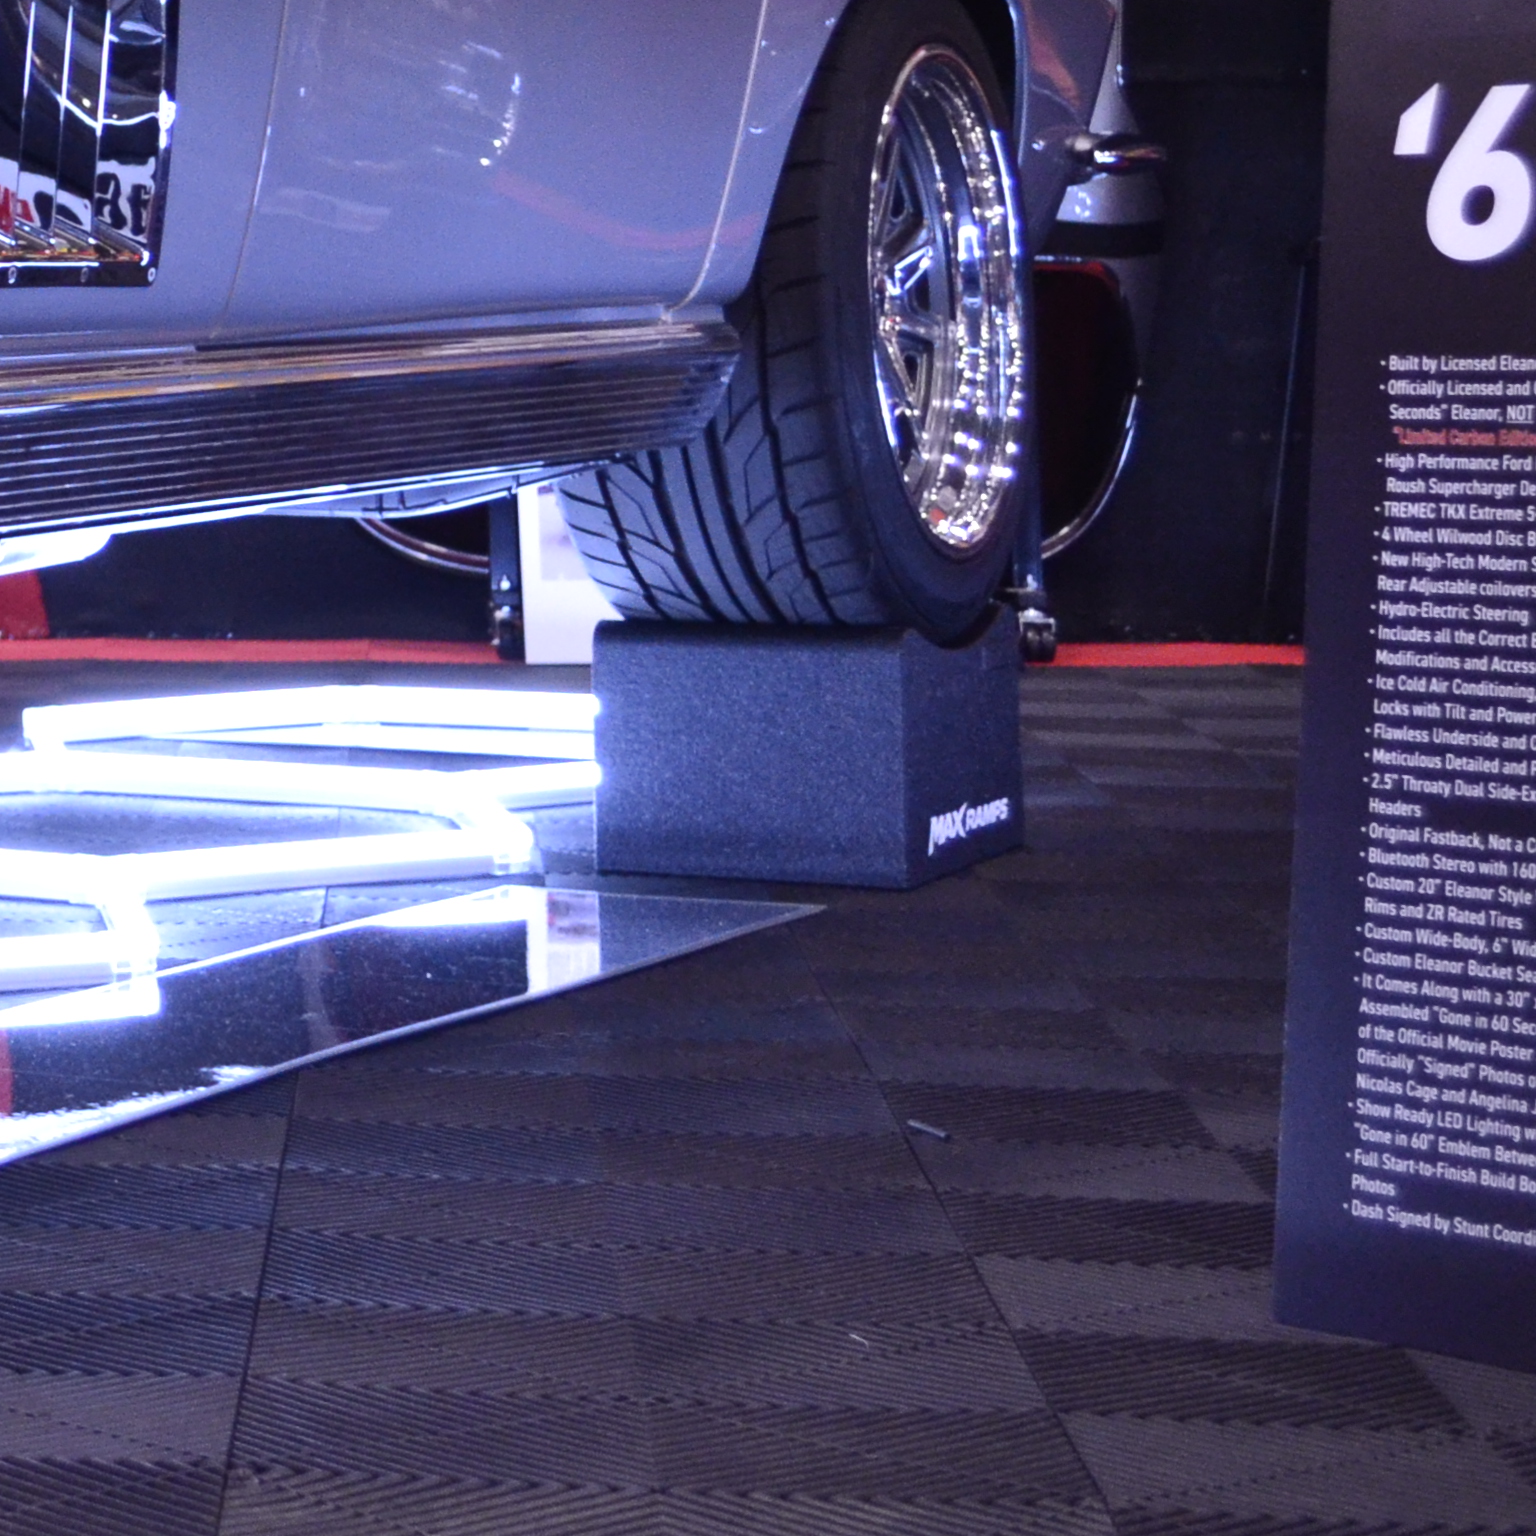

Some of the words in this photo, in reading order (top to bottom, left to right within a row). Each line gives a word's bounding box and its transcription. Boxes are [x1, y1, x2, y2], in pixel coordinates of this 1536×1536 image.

[1389, 355, 1419, 370] Built
[1422, 356, 1437, 374] by
[1441, 355, 1497, 370] Licensed
[1500, 355, 1536, 370] Elean
[1388, 380, 1444, 398] Officially
[1447, 380, 1503, 395] Licensed
[1506, 381, 1530, 395] and
[1389, 404, 1448, 420] Seconds"
[1451, 405, 1503, 422] Eleanor,
[1507, 405, 1535, 423] NOT
[1385, 453, 1414, 472] High
[1418, 453, 1498, 470] Performance
[1503, 455, 1532, 470] Ford
[1387, 477, 1425, 493] Roush
[1429, 478, 1517, 499] Supercharger
[1383, 501, 1436, 518] TREMEC
[1439, 503, 1466, 519] TKX
[1470, 504, 1523, 521] Extreme
[1381, 526, 1391, 541] 4
[1393, 527, 1433, 543] Wheel
[1437, 528, 1492, 545] Wilwood
[1496, 530, 1523, 546] Disc
[1381, 551, 1408, 566] New
[1412, 552, 1474, 571] High-Tech
[1478, 555, 1527, 571] Modern
[1378, 575, 1407, 591] Rear
[1409, 577, 1477, 596] Adjustable
[1379, 600, 1469, 619] Hydro-Electric
[1473, 604, 1529, 626] Steering
[1378, 625, 1431, 642] Includes
[1434, 628, 1450, 643] all
[1455, 629, 1475, 644] the
[1478, 629, 1527, 647] Correct
[1376, 649, 1460, 669] Modifications
[1464, 656, 1487, 670] and
[1376, 674, 1394, 690] Ice
[1398, 675, 1426, 692] Cold
[1429, 677, 1449, 693] Air
[1374, 699, 1409, 716] Locks
[1412, 702, 1440, 717] with
[1444, 703, 1466, 719] Tilt
[1469, 707, 1493, 721] and
[1374, 723, 1428, 742] Flawless
[1433, 728, 1499, 747] Underside
[1502, 735, 1526, 750] and
[1372, 748, 1441, 768] Meticulous
[1446, 754, 1499, 773] Detailed
[1502, 760, 1527, 775] and
[1371, 773, 1398, 789] 2.5"
[1402, 775, 1451, 797] Throaty
[1455, 780, 1483, 797] Dual
[1369, 797, 1421, 817] Headers
[928, 802, 967, 857] MAX
[1369, 823, 1420, 844] Original
[1423, 828, 1484, 850] Fastback,
[1488, 834, 1511, 851] Not
[1515, 840, 1523, 852] a
[1368, 847, 1429, 868] Bluetooth
[1433, 854, 1475, 873] Stereo
[1479, 860, 1507, 876] with
[1367, 872, 1414, 892] Custom
[1418, 878, 1441, 894] 20"
[1445, 880, 1495, 900] Eleanor
[1499, 886, 1532, 906] Style
[1364, 897, 1396, 915] Rims
[1399, 903, 1423, 918] and
[1426, 904, 1444, 920] ZR
[1448, 906, 1486, 925] Rated
[1489, 911, 1523, 929] Tires
[1364, 923, 1412, 942] Custom
[1416, 928, 1489, 954] Wide-Body,
[1363, 947, 1411, 967] Custom
[1415, 953, 1464, 974] Eleanor
[1468, 960, 1512, 980] Bucket
[1362, 973, 1371, 988] It
[1375, 974, 1418, 994] Comes
[1421, 980, 1459, 1003] Along
[1462, 987, 1490, 1003] with
[1494, 993, 1502, 1005] a
[1507, 991, 1530, 1007] 30"
[1359, 997, 1428, 1021] Assembled
[1432, 1006, 1471, 1027] "Gone
[1475, 1012, 1488, 1029] in
[1491, 1016, 1509, 1031] 60
[1358, 1024, 1371, 1039] of
[1374, 1025, 1394, 1042] the
[1398, 1028, 1443, 1048] Official
[1447, 1035, 1486, 1054] Movie
[1491, 1040, 1534, 1060] Poster
[1357, 1048, 1415, 1073] Officially
[1417, 1055, 1475, 1079] "Signed"
[1479, 1065, 1524, 1086] Photos
[1356, 1073, 1402, 1094] Nicolas
[1406, 1080, 1438, 1102] Cage
[1441, 1088, 1465, 1103] and
[1469, 1090, 1527, 1112] Angelina
[1356, 1098, 1391, 1118] Show
[1394, 1104, 1433, 1127] Ready
[1437, 1111, 1463, 1129] LED
[1467, 1115, 1521, 1142] Lighting
[1354, 1122, 1391, 1144] "Gone
[1395, 1130, 1407, 1147] in
[1411, 1133, 1434, 1150] 60"
[1438, 1136, 1491, 1159] Emblem
[1354, 1149, 1378, 1168] Full
[1382, 1153, 1476, 1183] Start-to-Finish
[1480, 1169, 1515, 1190] Build
[1352, 1174, 1396, 1196] Photos
[1351, 1199, 1383, 1219] Dash
[1387, 1205, 1430, 1228] Signed
[1434, 1214, 1450, 1234] by
[1454, 1217, 1490, 1238] Stunt
